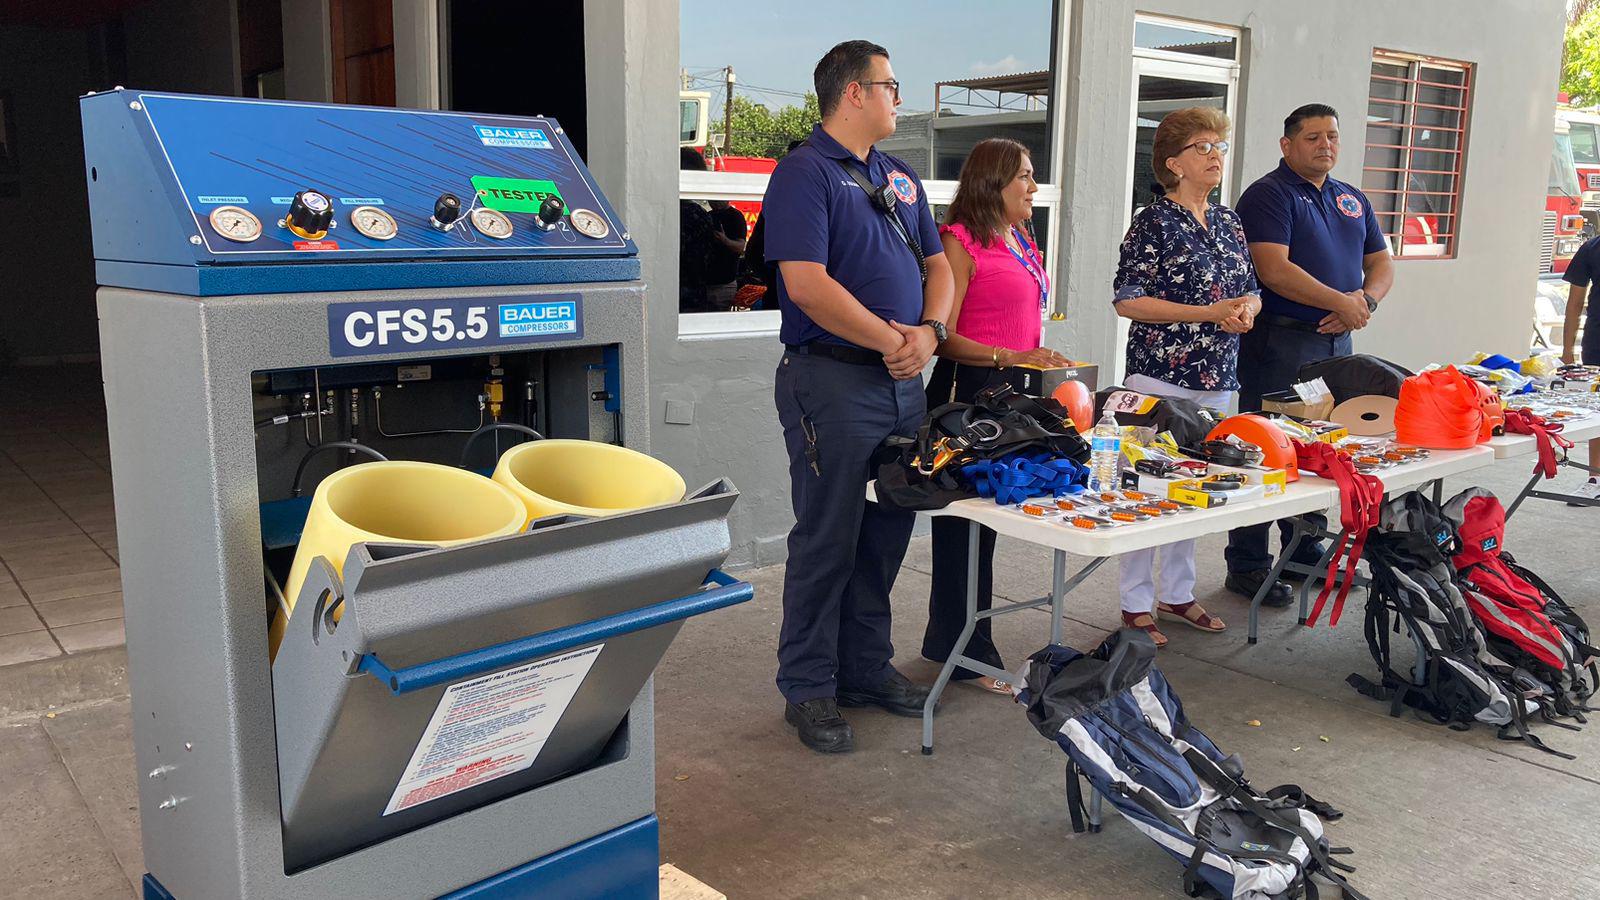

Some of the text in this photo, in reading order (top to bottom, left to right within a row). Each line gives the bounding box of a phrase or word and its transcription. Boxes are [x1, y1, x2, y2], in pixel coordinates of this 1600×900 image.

[480, 128, 543, 139] BAUER
[488, 138, 545, 147] COMPRESSORS
[488, 188, 552, 202] TESTE
[558, 221, 571, 232] 2
[504, 305, 571, 321] BAUER
[507, 321, 569, 334] COMPRESSORS
[506, 667, 530, 678] STATION
[530, 658, 561, 671] OPERATING
[560, 648, 599, 662] INSTRUCTIONS
